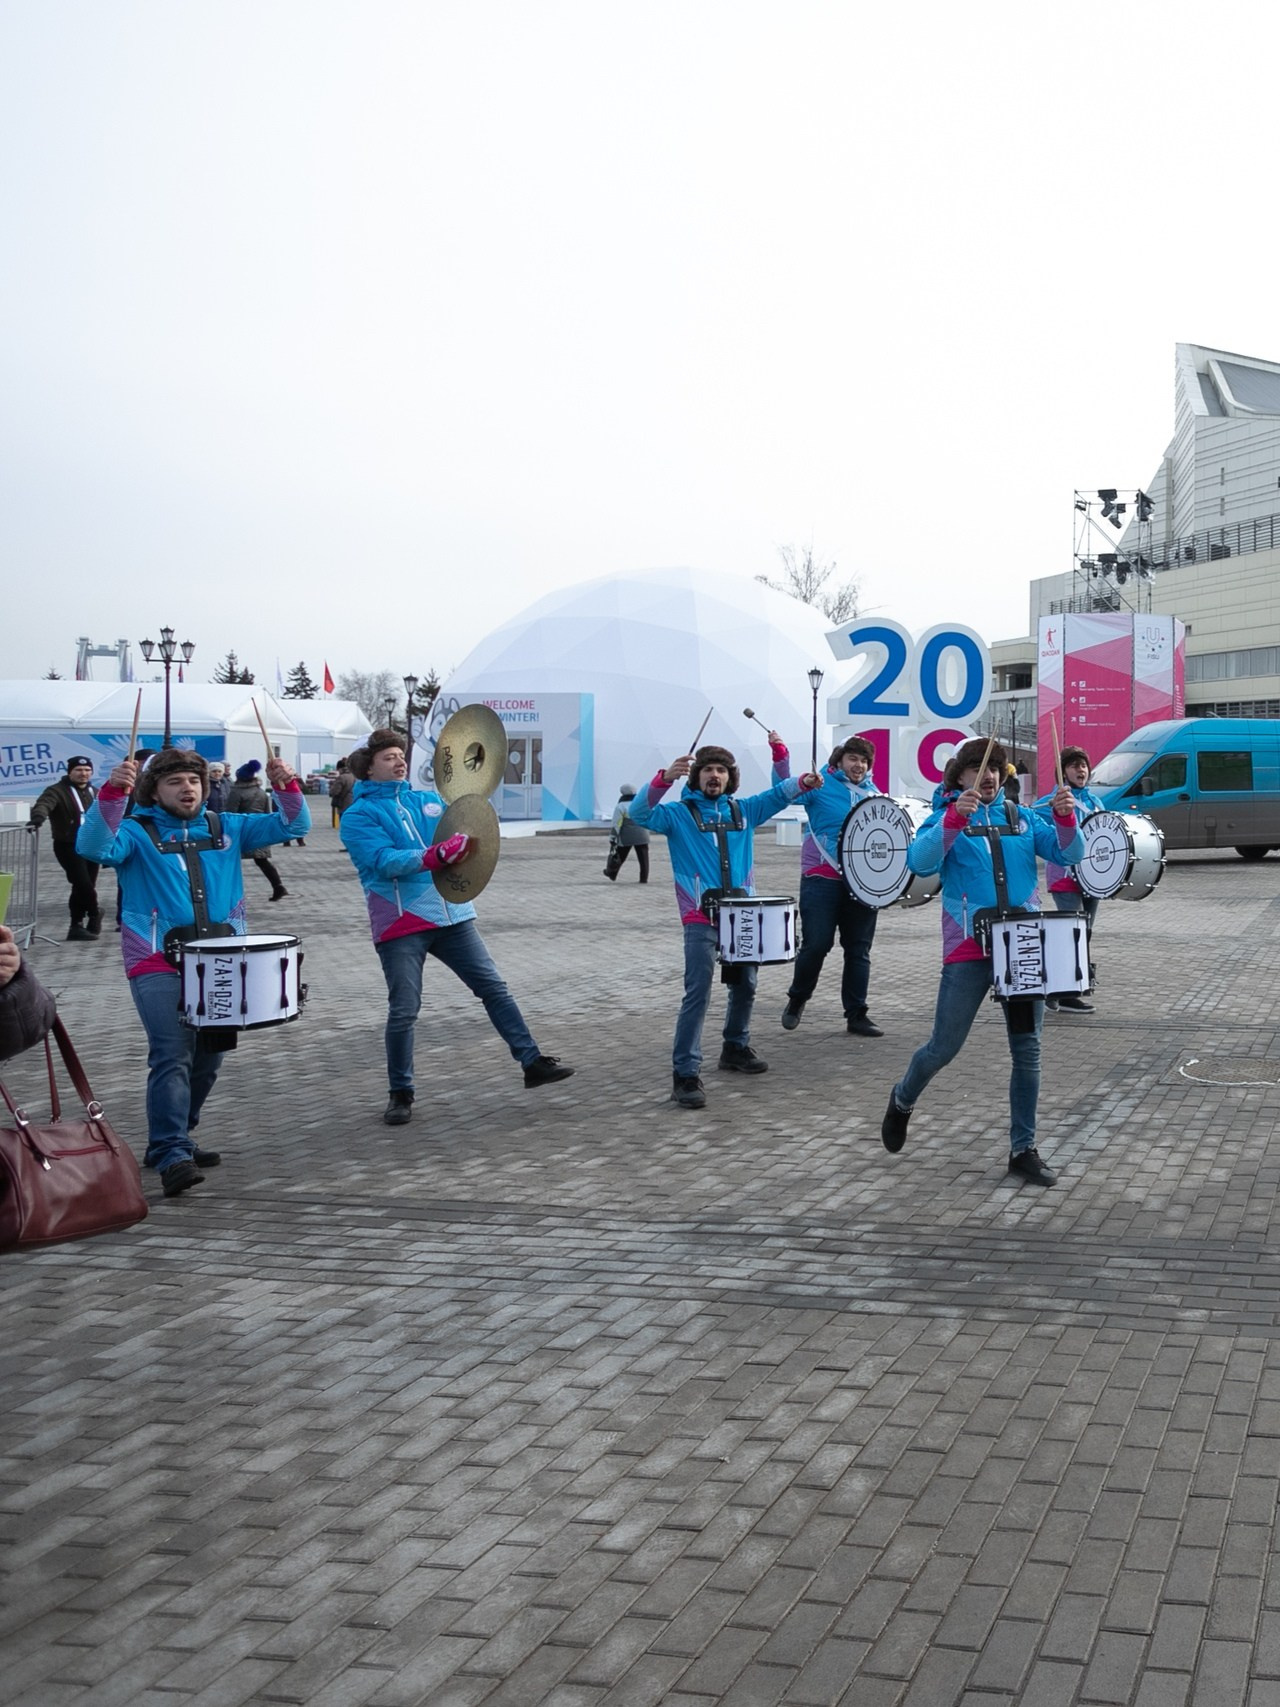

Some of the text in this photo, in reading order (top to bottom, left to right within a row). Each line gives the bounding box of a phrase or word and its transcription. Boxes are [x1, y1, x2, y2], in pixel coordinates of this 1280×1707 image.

[848, 625, 985, 719] 20
[482, 699, 535, 710] WELCOME
[0, 742, 52, 763] TER
[870, 840, 888, 852] drum
[870, 851, 888, 859] show
